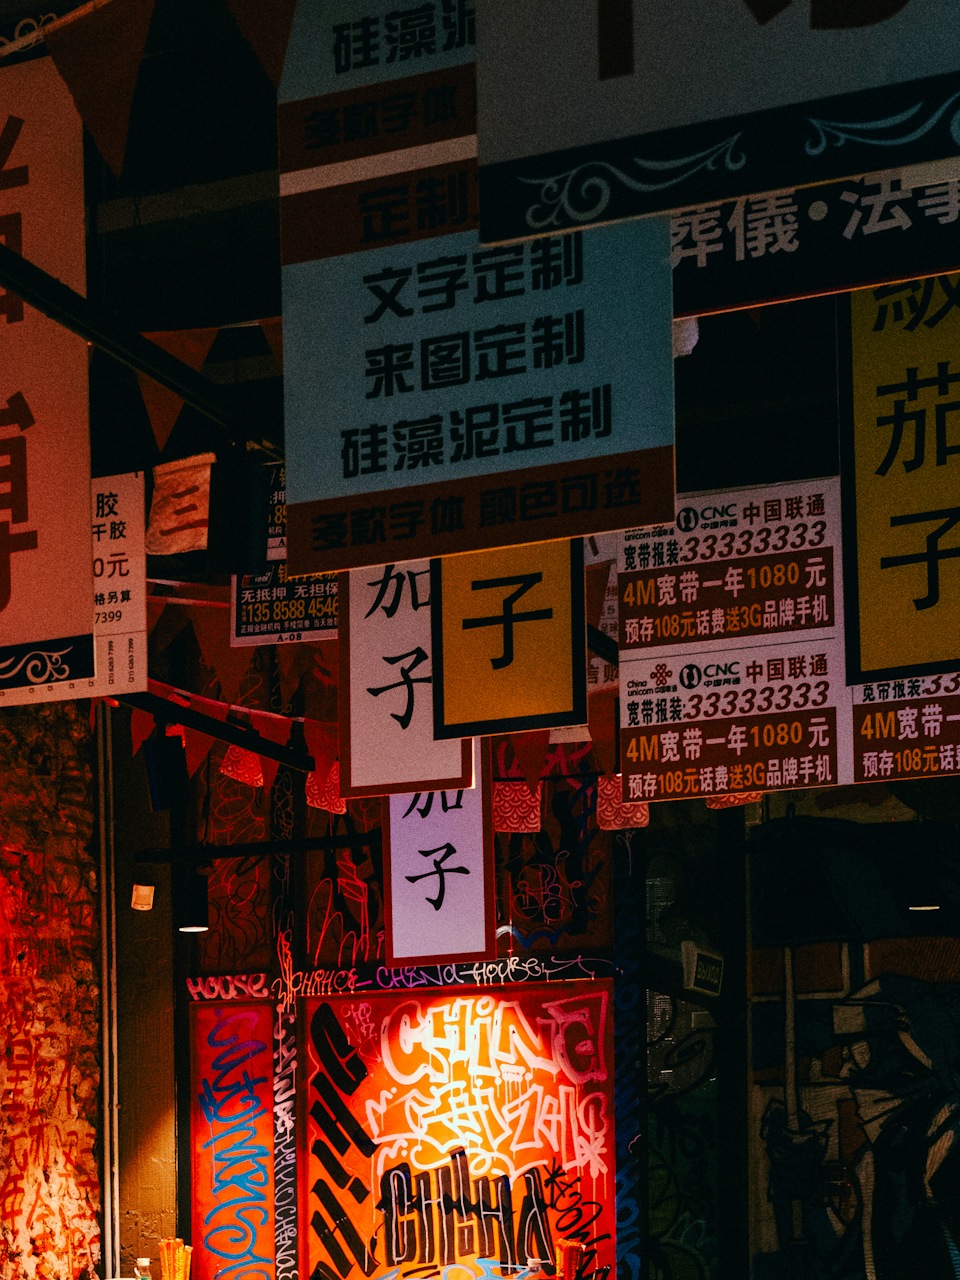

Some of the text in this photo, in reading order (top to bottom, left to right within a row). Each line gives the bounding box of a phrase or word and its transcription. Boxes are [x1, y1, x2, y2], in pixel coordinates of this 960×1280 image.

[358, 171, 476, 243] 定制
[363, 231, 584, 324] 文字定制
[365, 310, 585, 399] 来图定制
[341, 384, 611, 479] 硅藻泥定制
[312, 495, 464, 551] 多款字体
[701, 503, 737, 520] CNC
[743, 493, 825, 526] 中国联通
[247, 602, 270, 622] 135
[273, 599, 305, 620] 8588
[462, 572, 552, 670] 子
[704, 662, 740, 678] CNC
[746, 653, 828, 684] 中国联通
[862, 744, 960, 778] 预存108元话
